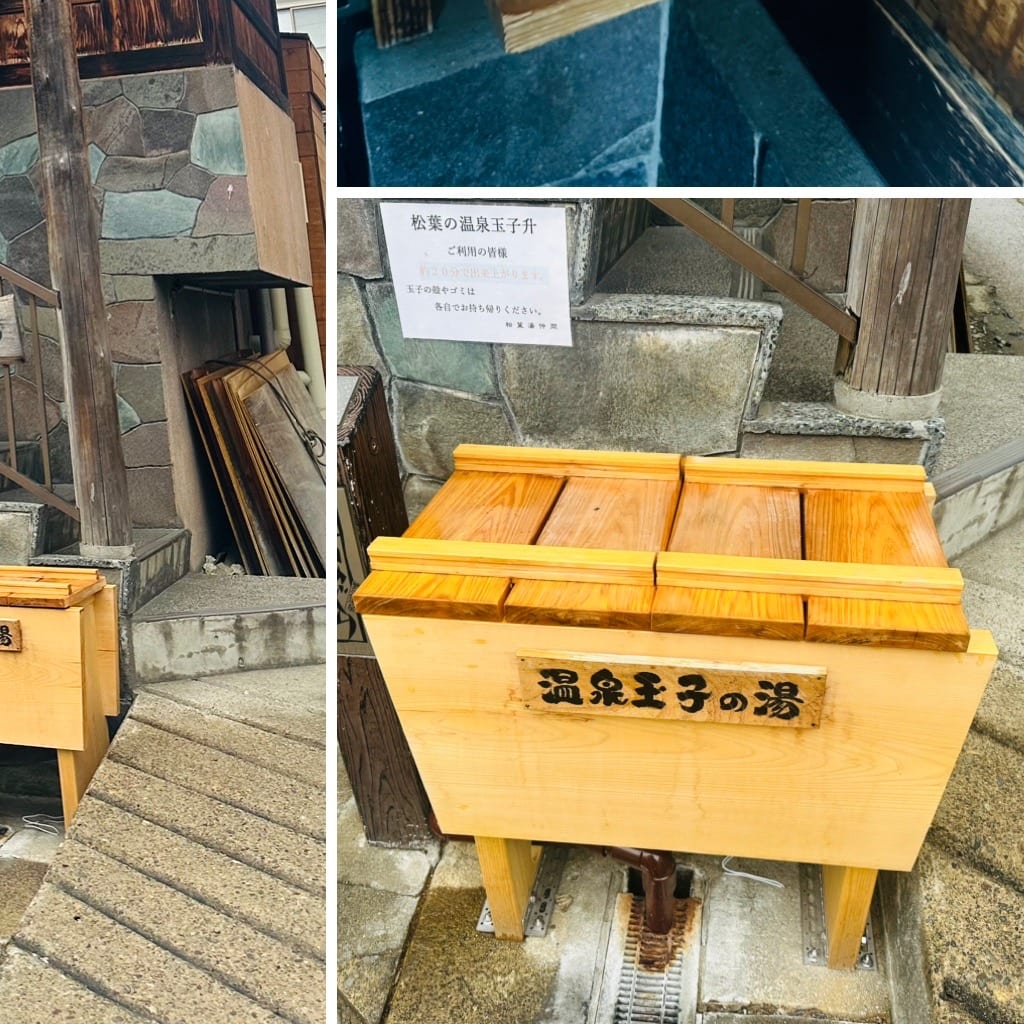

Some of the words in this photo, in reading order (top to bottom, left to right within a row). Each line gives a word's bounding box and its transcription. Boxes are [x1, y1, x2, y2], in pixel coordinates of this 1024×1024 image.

[447, 246, 508, 258] ご利用の皆様
[407, 285, 476, 296] 玉子の殻やゴミは
[434, 302, 542, 316] 各自でお持ち帰りください。
[537, 668, 805, 720] 温泉玉子の湯
